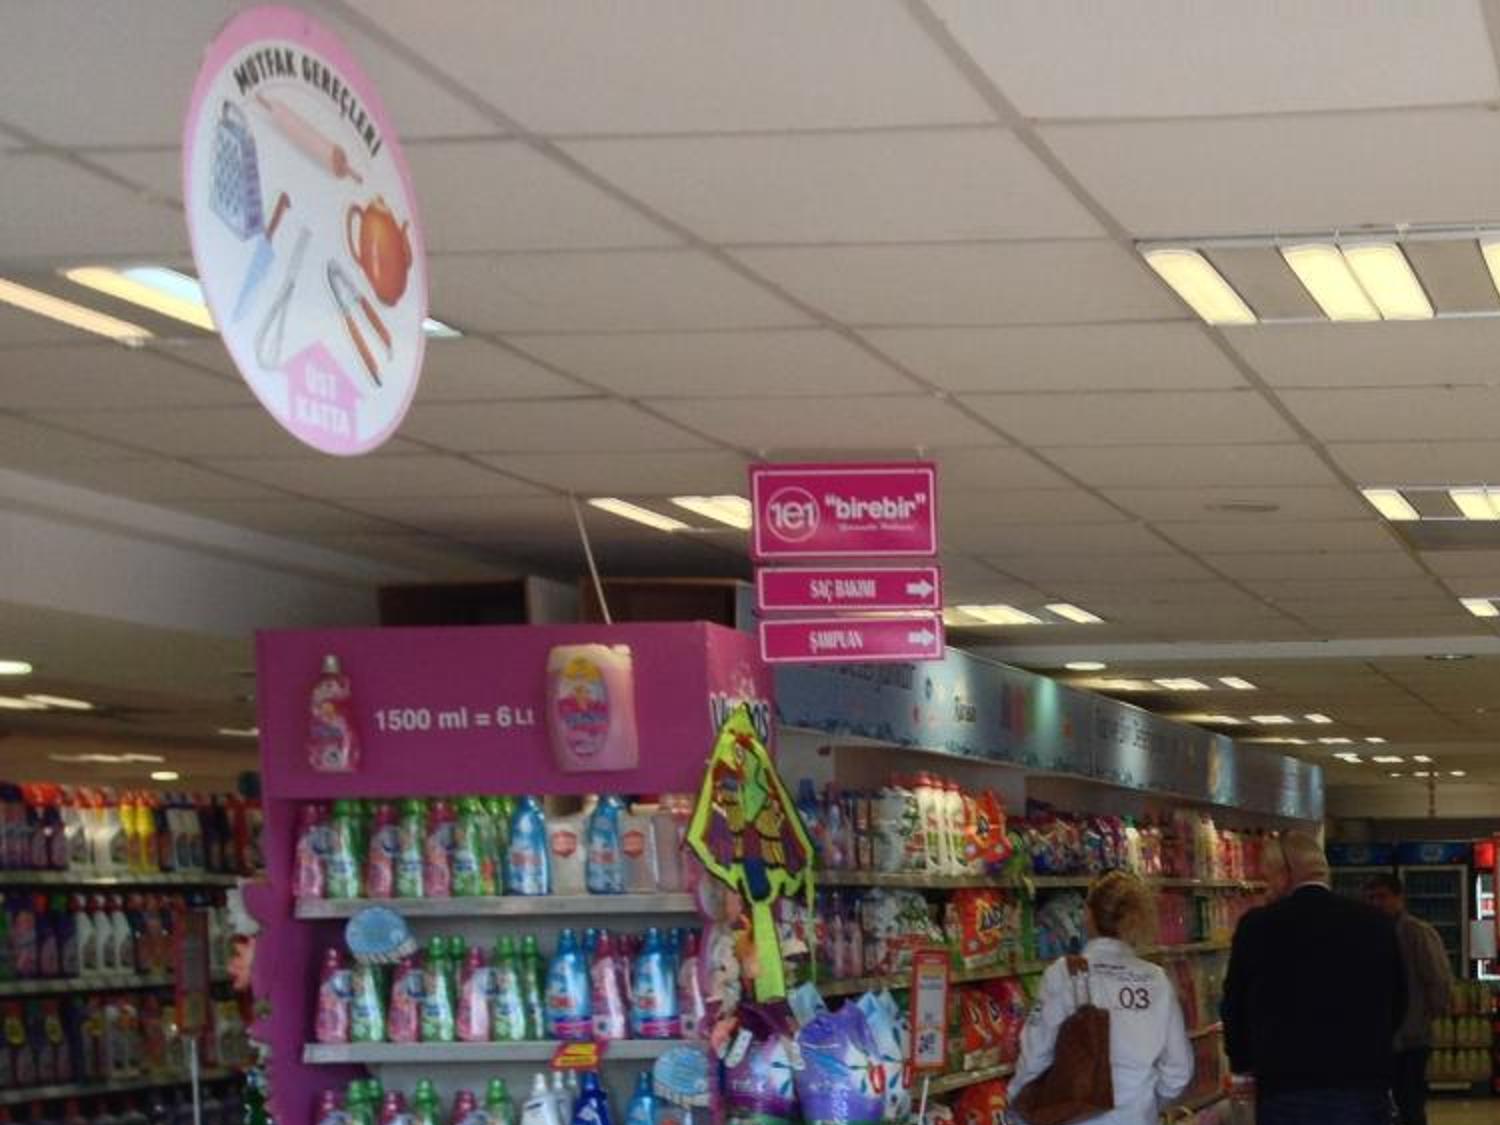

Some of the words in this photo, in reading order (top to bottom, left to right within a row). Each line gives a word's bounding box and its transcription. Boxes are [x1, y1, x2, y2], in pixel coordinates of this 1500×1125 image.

[233, 48, 297, 95] MUTFAK
[809, 579, 833, 603] SAÇ
[375, 709, 430, 731] 1500
[439, 707, 468, 729] ml
[497, 706, 512, 728] 6
[1119, 987, 1150, 1010] 03
